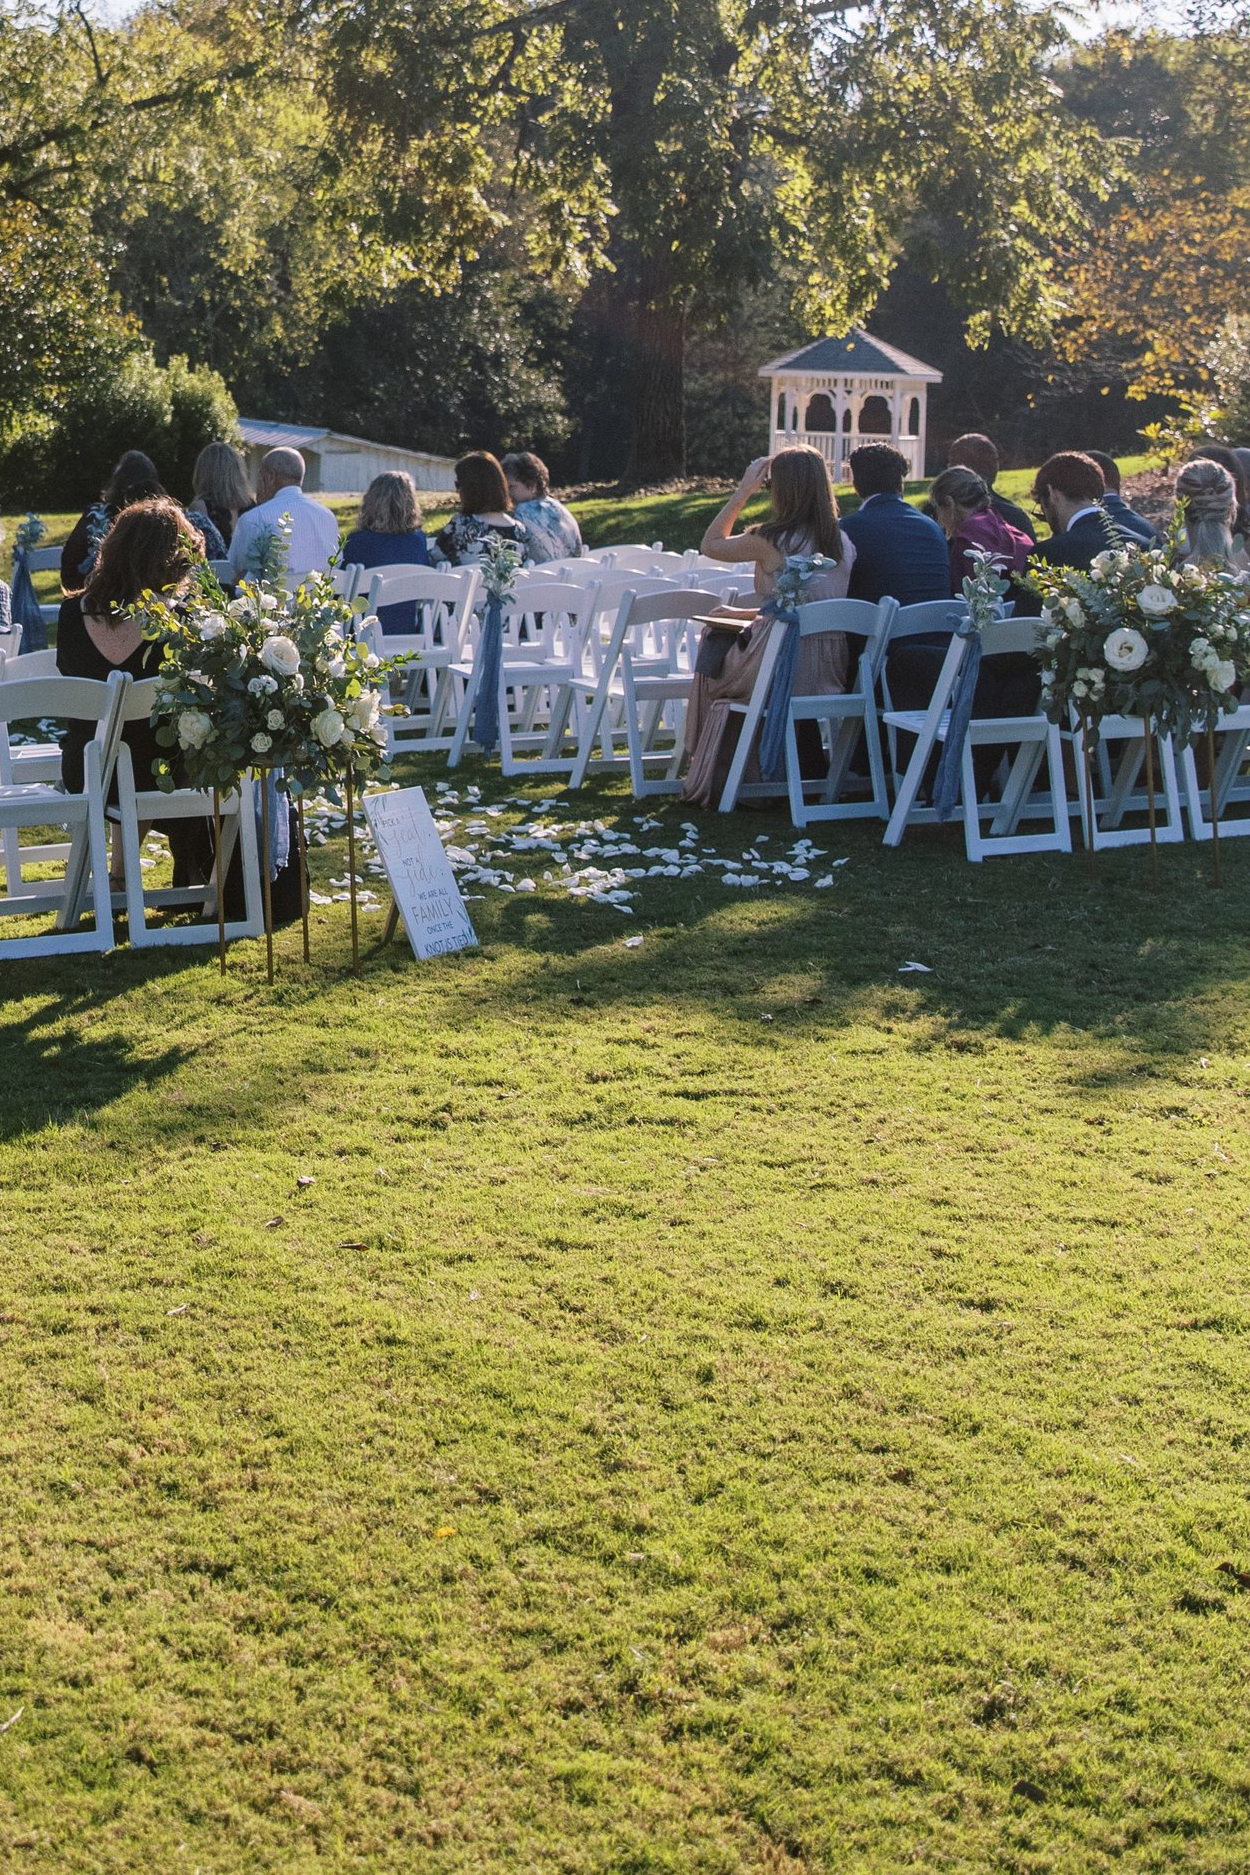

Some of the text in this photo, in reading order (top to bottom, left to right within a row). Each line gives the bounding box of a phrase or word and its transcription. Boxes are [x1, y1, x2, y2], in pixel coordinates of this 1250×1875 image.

[402, 857, 414, 867] NOT
[418, 887, 449, 900] WE ARE ALL
[412, 897, 454, 925] FAMILY
[426, 921, 454, 935] ONCE THE
[424, 939, 448, 956] KNOT
